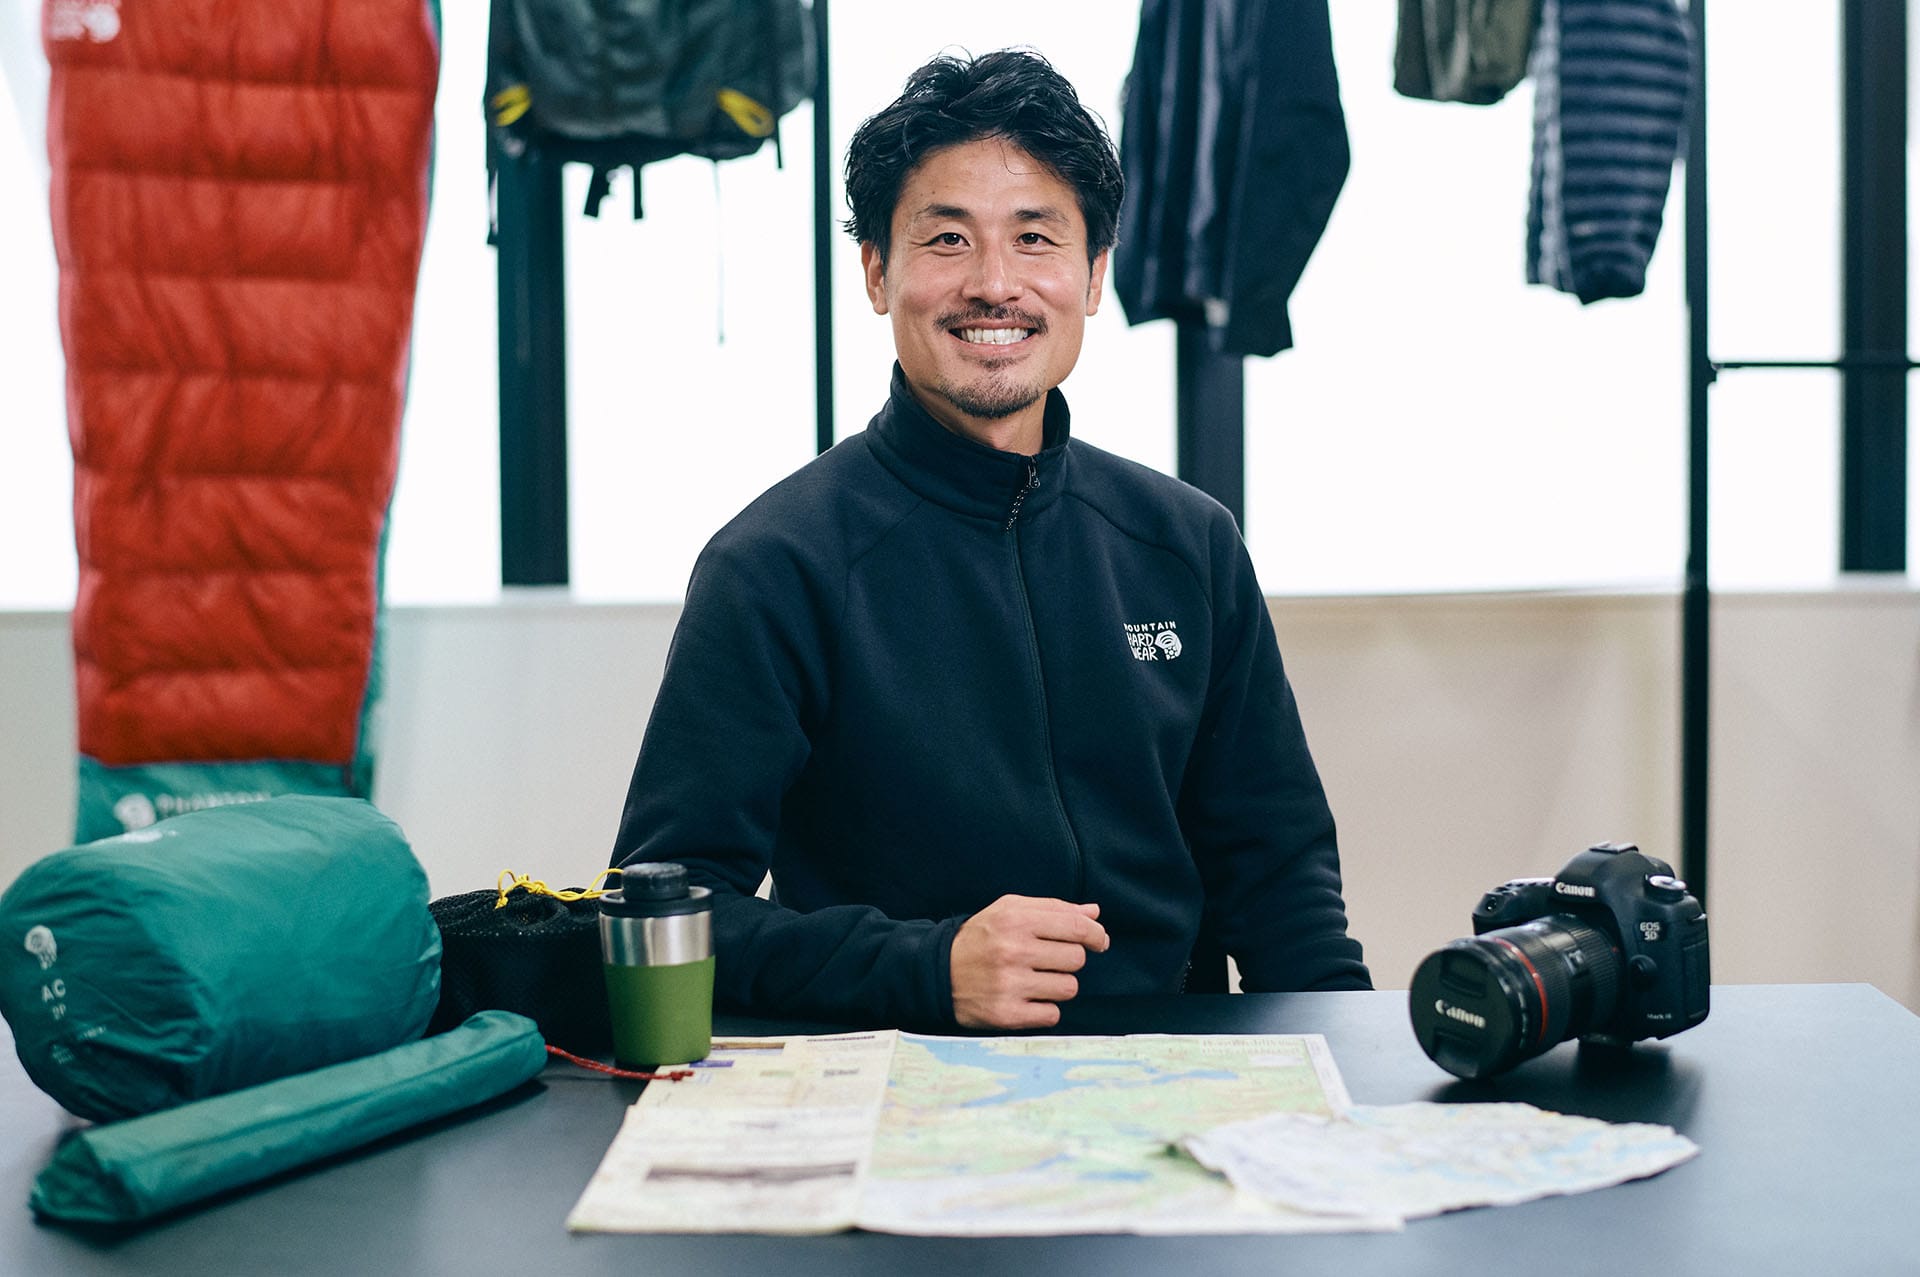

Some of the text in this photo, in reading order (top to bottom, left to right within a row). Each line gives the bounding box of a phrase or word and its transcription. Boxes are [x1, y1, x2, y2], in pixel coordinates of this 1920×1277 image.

[1126, 632, 1154, 647] HARD
[1555, 881, 1595, 897] Canon
[1640, 922, 1660, 931] EOS
[1644, 930, 1658, 940] 5D
[41, 978, 66, 1002] AC
[1434, 999, 1486, 1028] Canon
